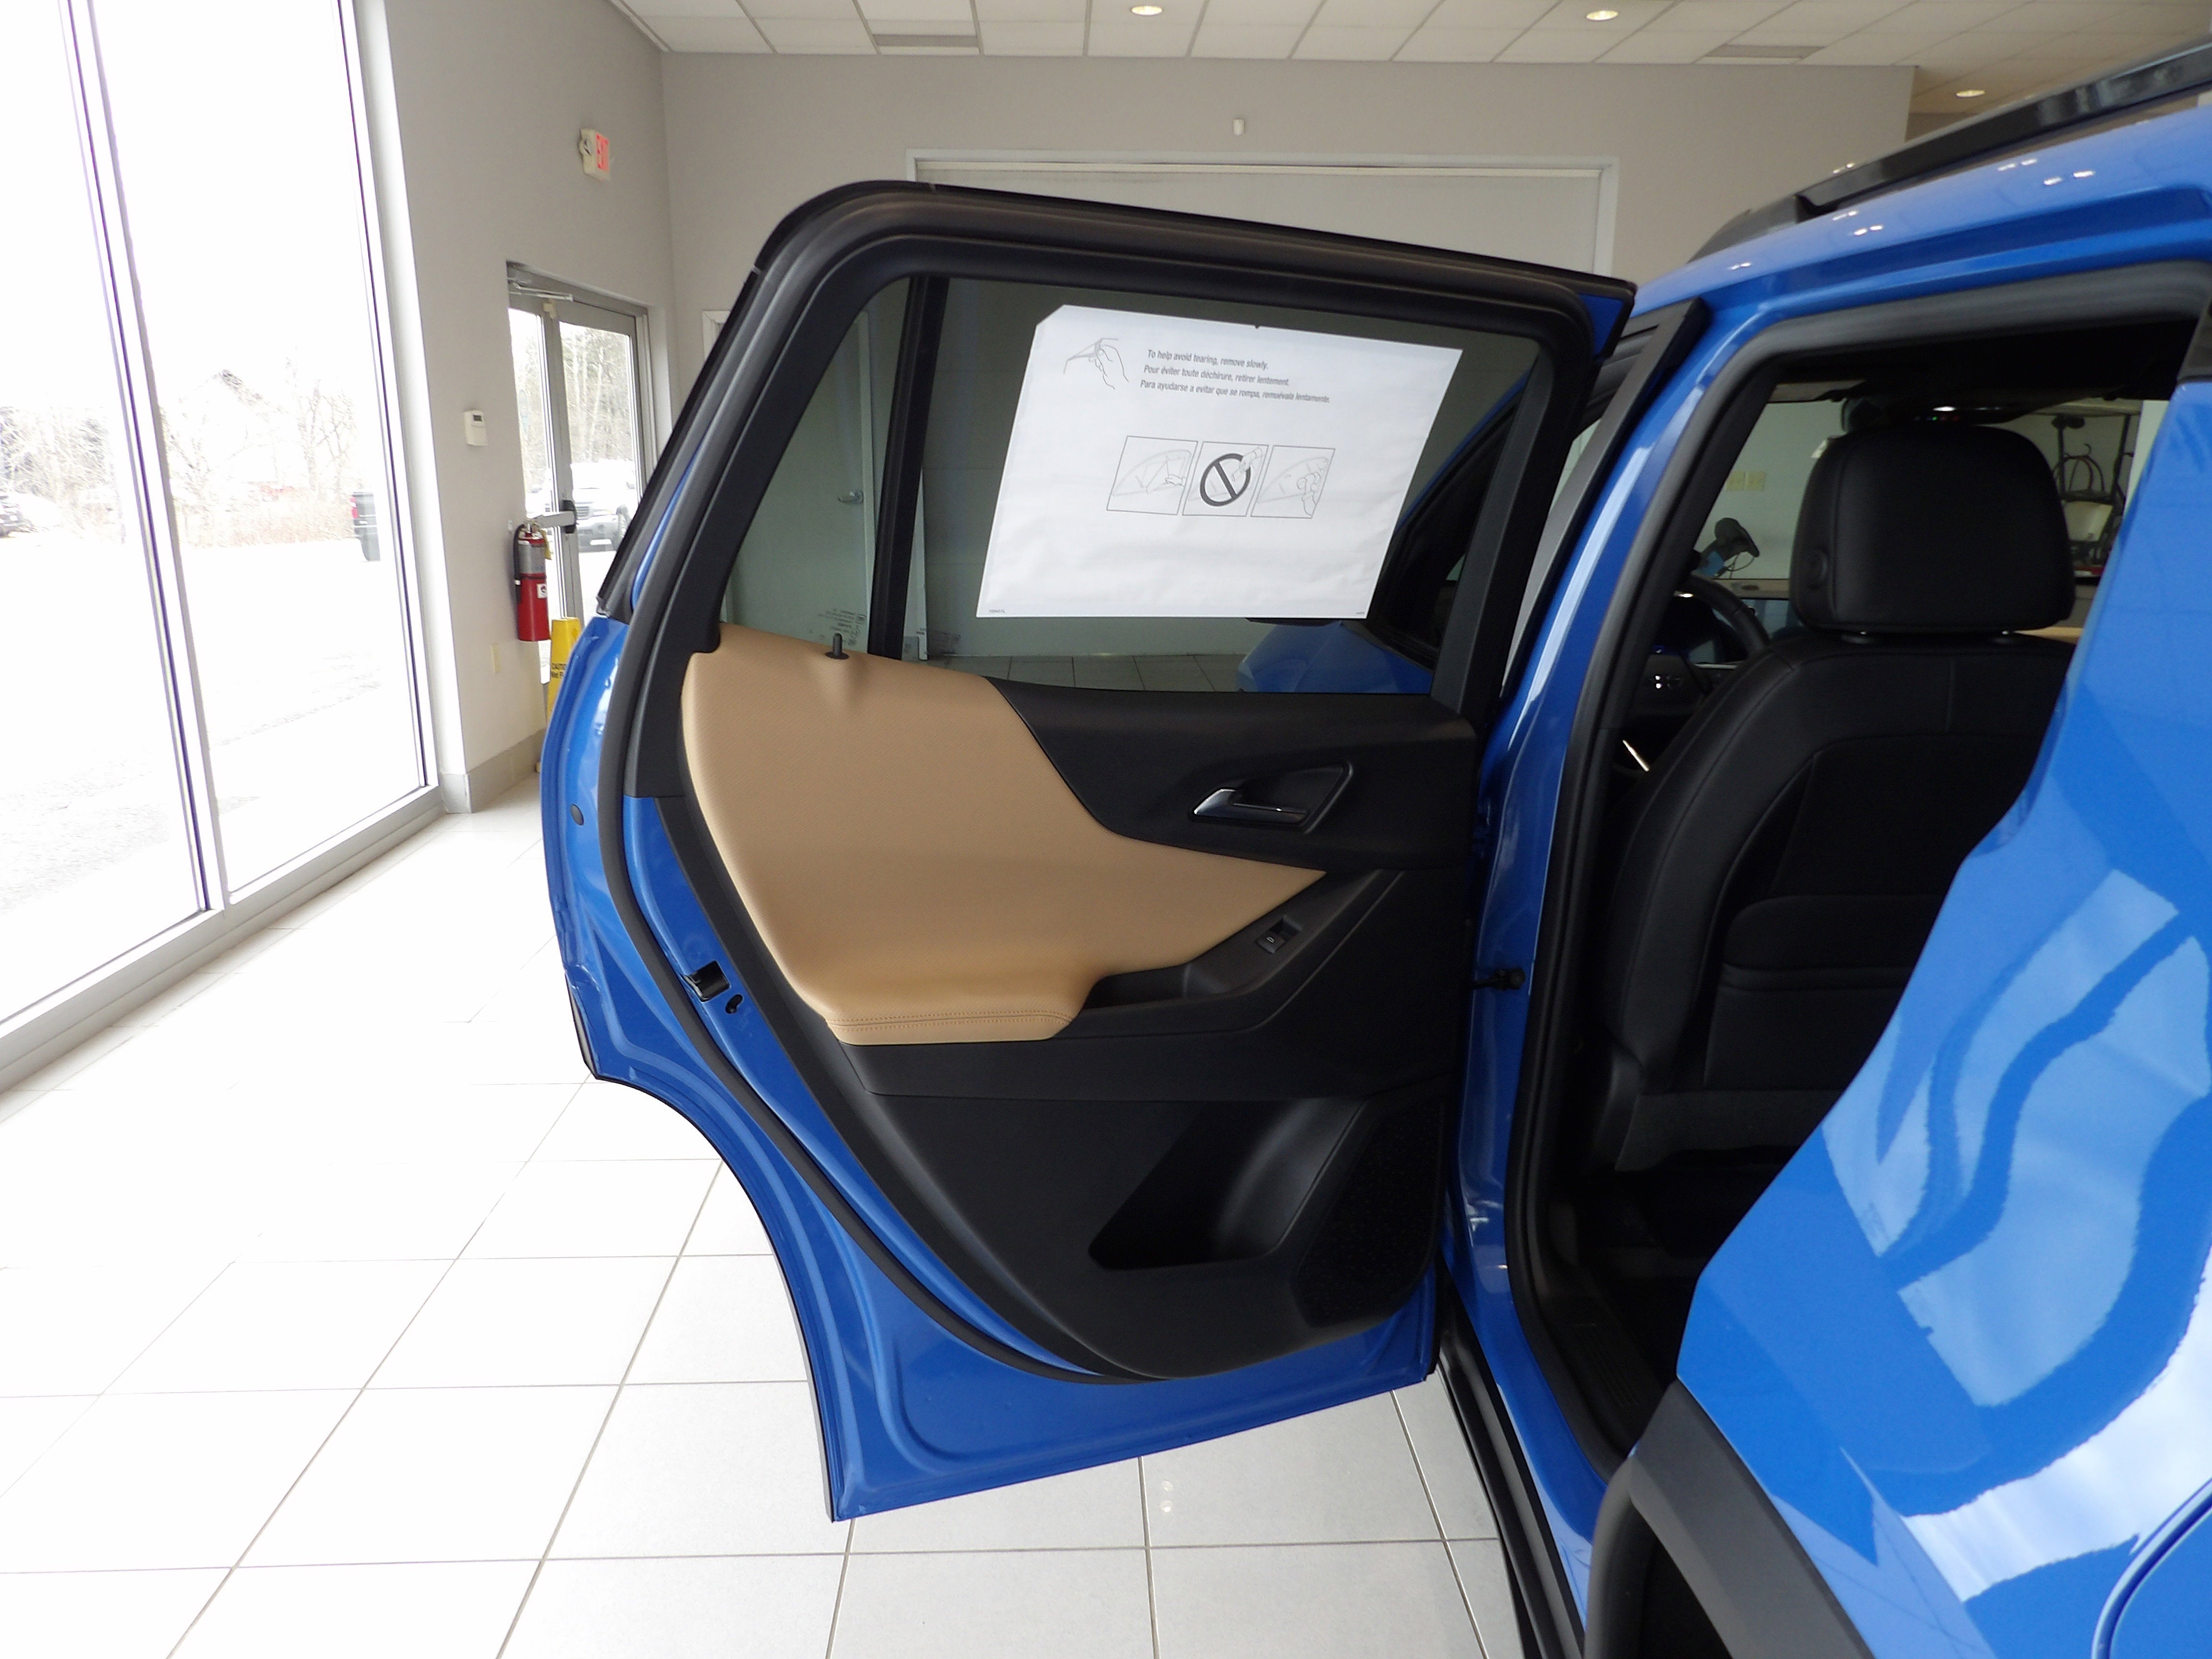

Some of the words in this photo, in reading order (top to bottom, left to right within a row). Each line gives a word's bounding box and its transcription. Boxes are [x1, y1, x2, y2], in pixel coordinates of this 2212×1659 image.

[1148, 349, 1155, 358] To
[1157, 350, 1172, 361] help
[1173, 353, 1192, 361] avoid
[1193, 354, 1217, 366] tearing,
[1220, 359, 1245, 367] remove
[1247, 360, 1268, 370] slowly.
[1144, 364, 1159, 373] Pour
[1161, 365, 1180, 376] éviter
[1182, 368, 1199, 377] toute
[1236, 374, 1256, 383] retirer
[1140, 379, 1155, 388] Para
[1157, 382, 1188, 391] ayudarse
[1196, 385, 1214, 394] evitar
[1216, 388, 1228, 396] que
